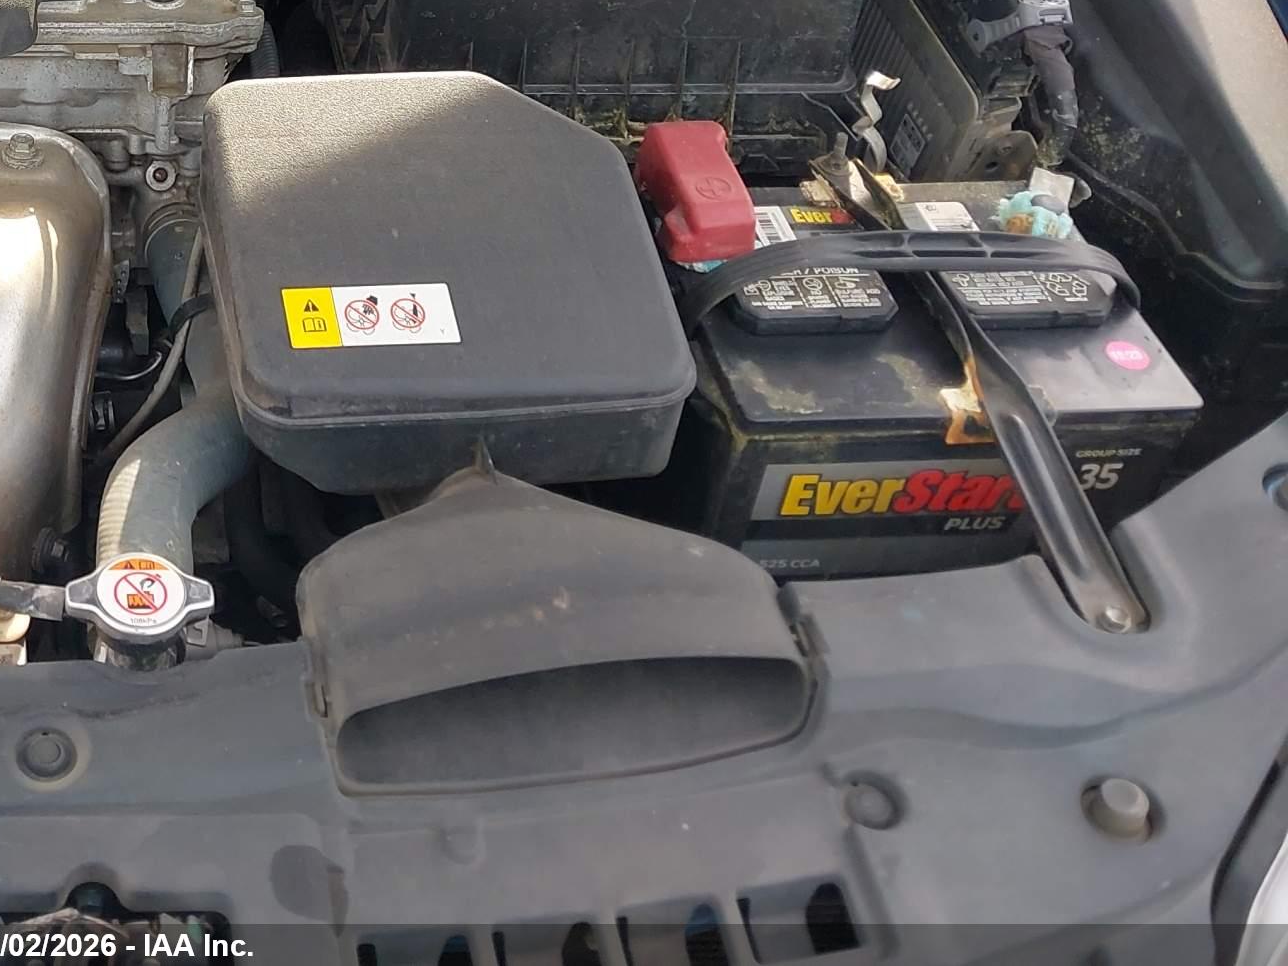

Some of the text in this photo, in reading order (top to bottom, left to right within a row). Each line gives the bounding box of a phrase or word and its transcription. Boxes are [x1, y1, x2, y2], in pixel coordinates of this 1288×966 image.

[1079, 463, 1124, 490] 35
[944, 516, 1006, 531] PLUS
[790, 559, 821, 569] CCA
